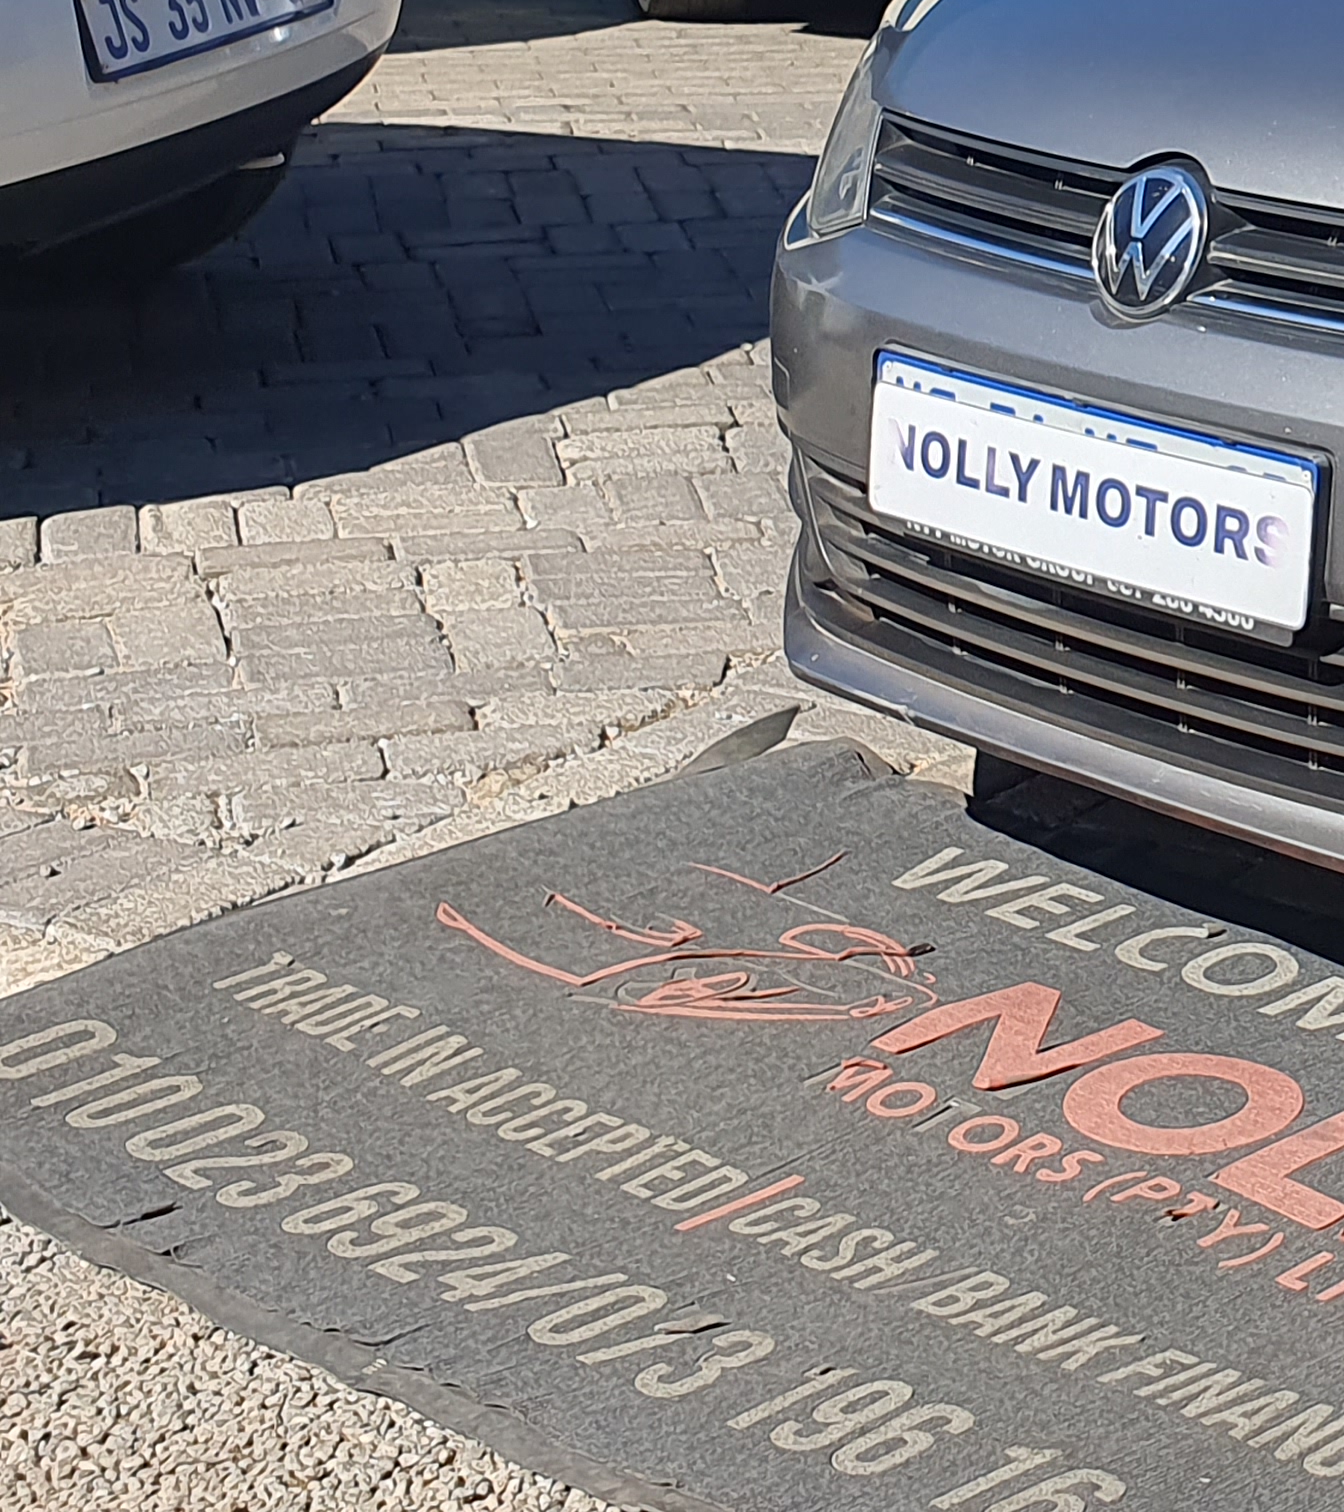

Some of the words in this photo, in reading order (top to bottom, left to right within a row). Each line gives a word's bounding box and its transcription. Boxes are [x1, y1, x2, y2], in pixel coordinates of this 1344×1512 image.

[888, 417, 1042, 504] NOLLY
[1049, 463, 1291, 568] MOTORS
[212, 949, 422, 1052] TRADE
[365, 1024, 485, 1088] IN
[0, 1018, 204, 1129] 010
[124, 1102, 355, 1209] 023
[725, 1362, 976, 1477] 196
